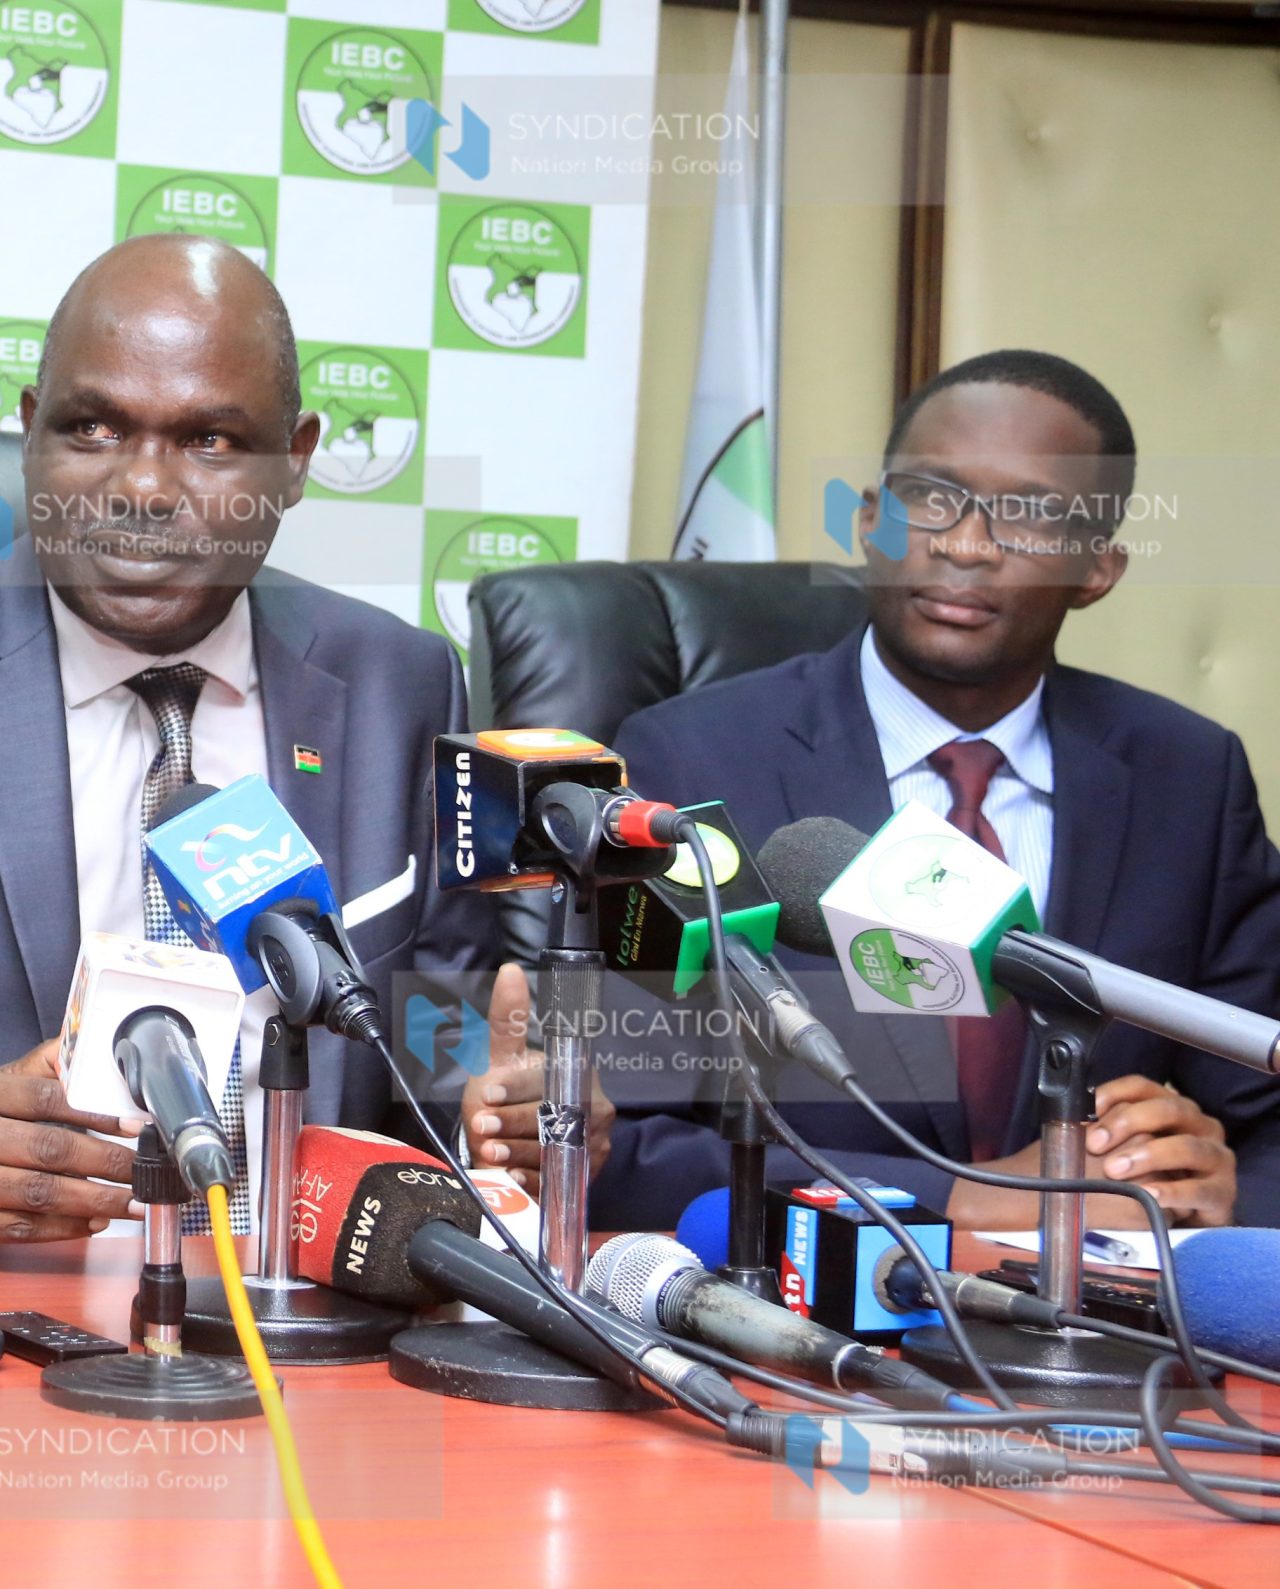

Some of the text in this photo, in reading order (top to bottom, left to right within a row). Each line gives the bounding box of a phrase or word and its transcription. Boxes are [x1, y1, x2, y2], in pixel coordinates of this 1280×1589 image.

[1, 7, 78, 38] IEBC
[331, 41, 405, 71] IEBC
[162, 188, 238, 218] IEBC
[482, 216, 553, 245] IEBC
[318, 361, 391, 390] IEBC
[468, 531, 540, 559] IEBC
[202, 833, 292, 902] ntv
[858, 941, 886, 986] IEBC
[346, 1196, 381, 1275] NEWS
[793, 1211, 808, 1266] NEWS
[783, 1273, 801, 1316] tn
